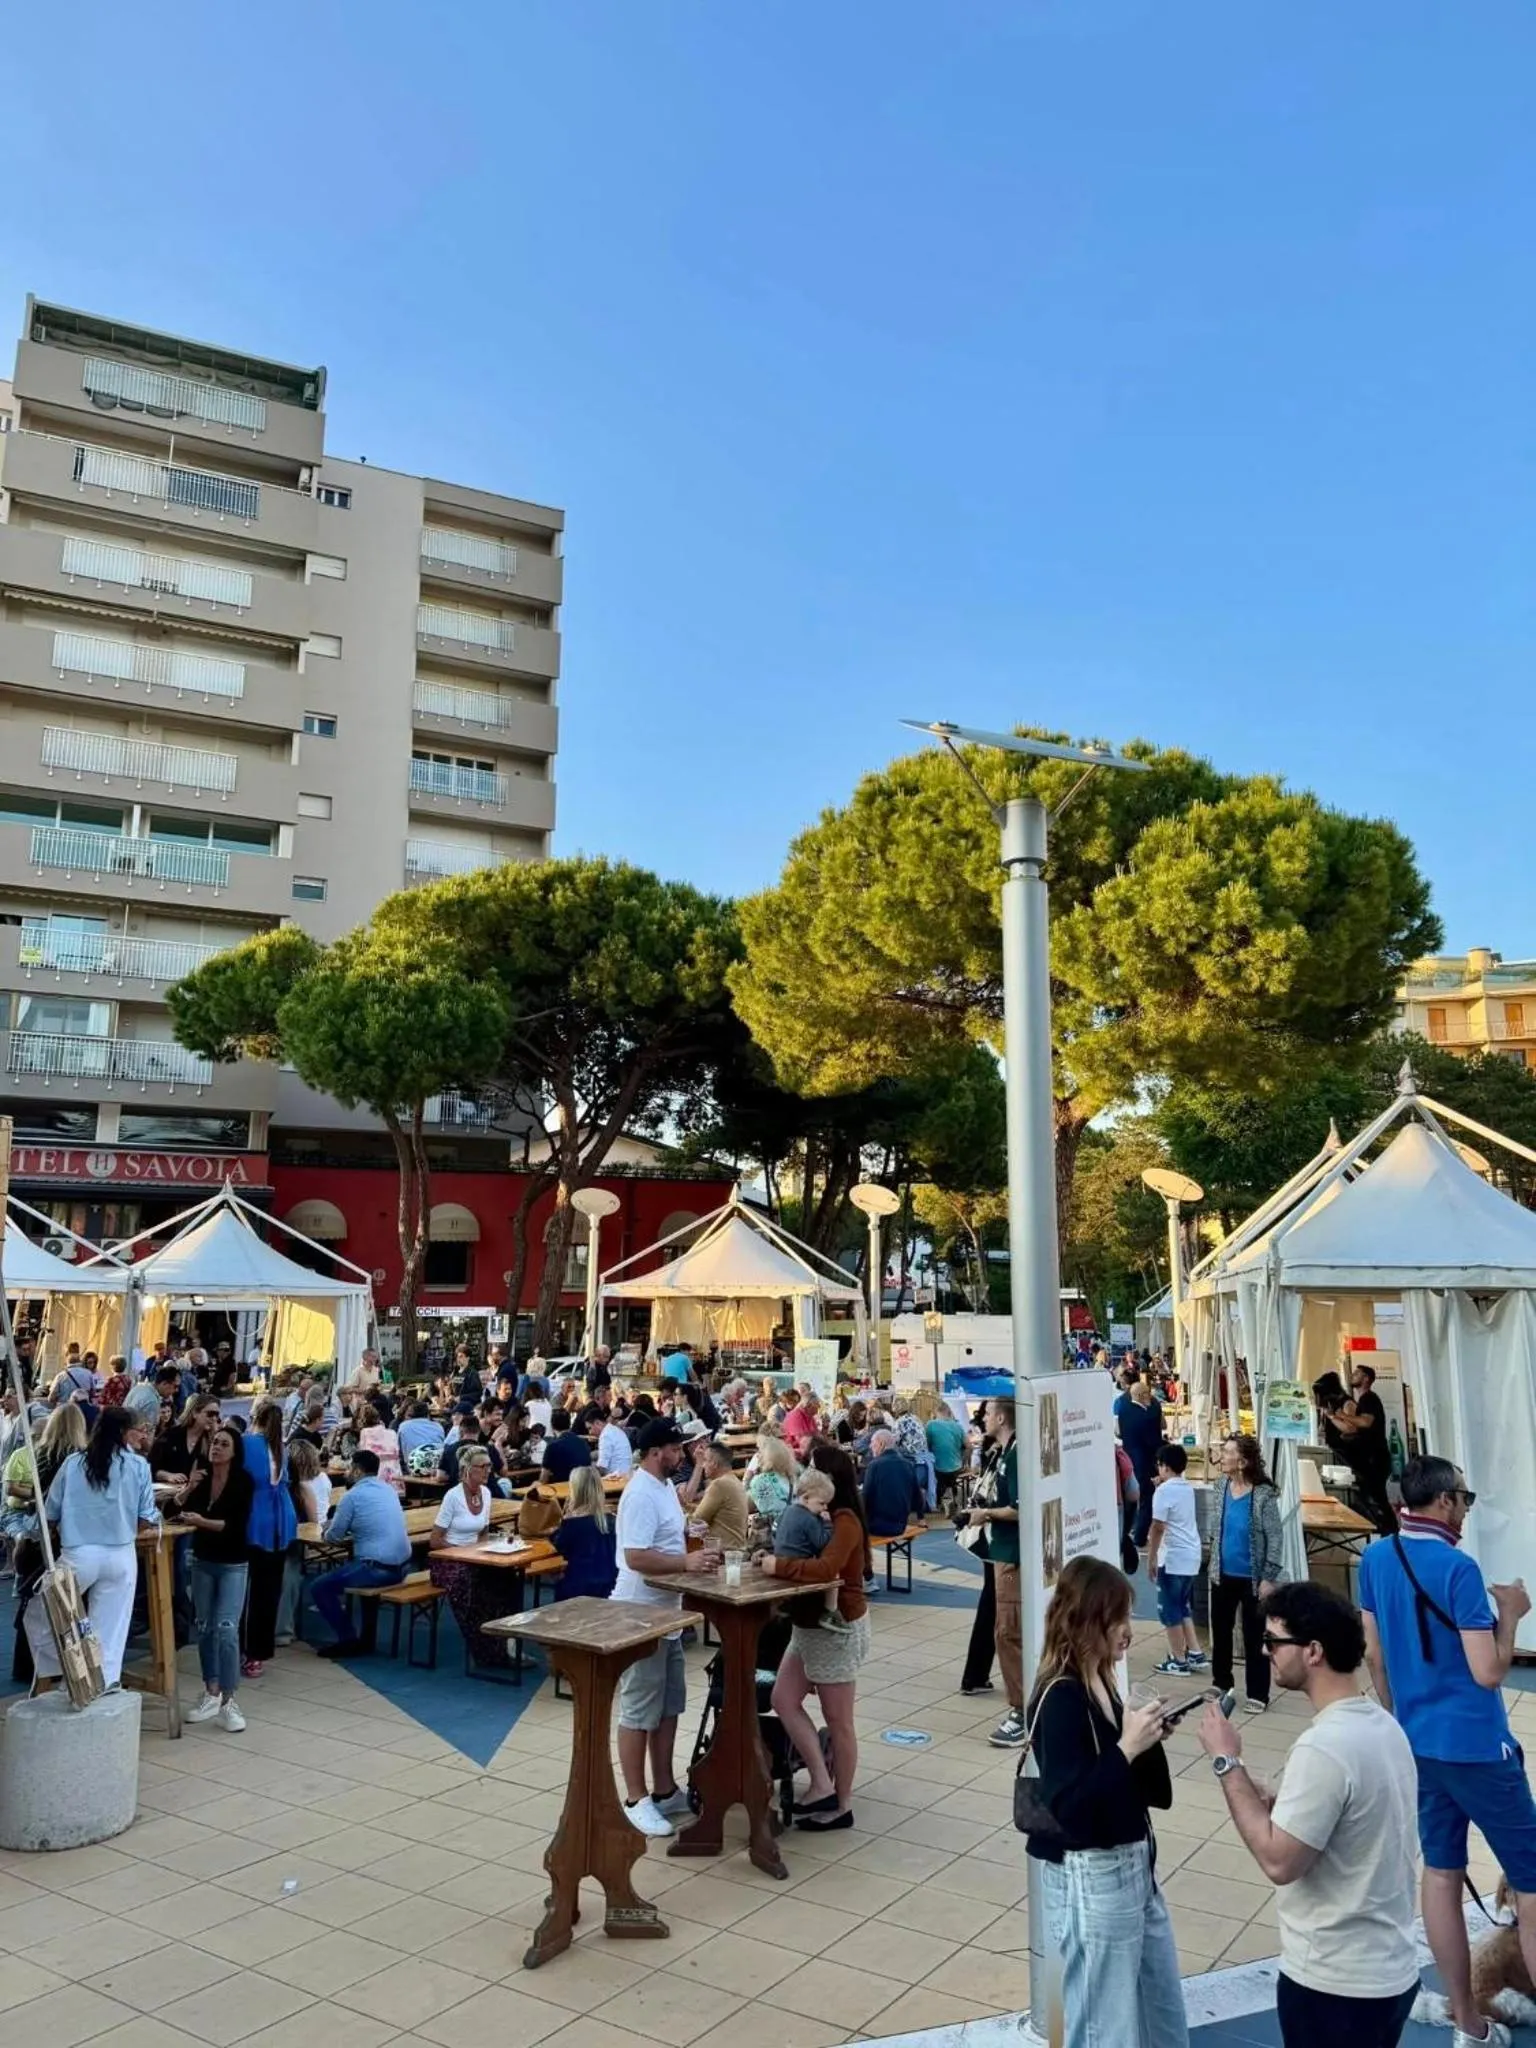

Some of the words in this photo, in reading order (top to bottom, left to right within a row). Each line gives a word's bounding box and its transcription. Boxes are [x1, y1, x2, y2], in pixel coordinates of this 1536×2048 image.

[12, 1147, 80, 1174] TEL
[124, 1154, 249, 1182] SAVOIA
[391, 1307, 441, 1316] TACCHI
